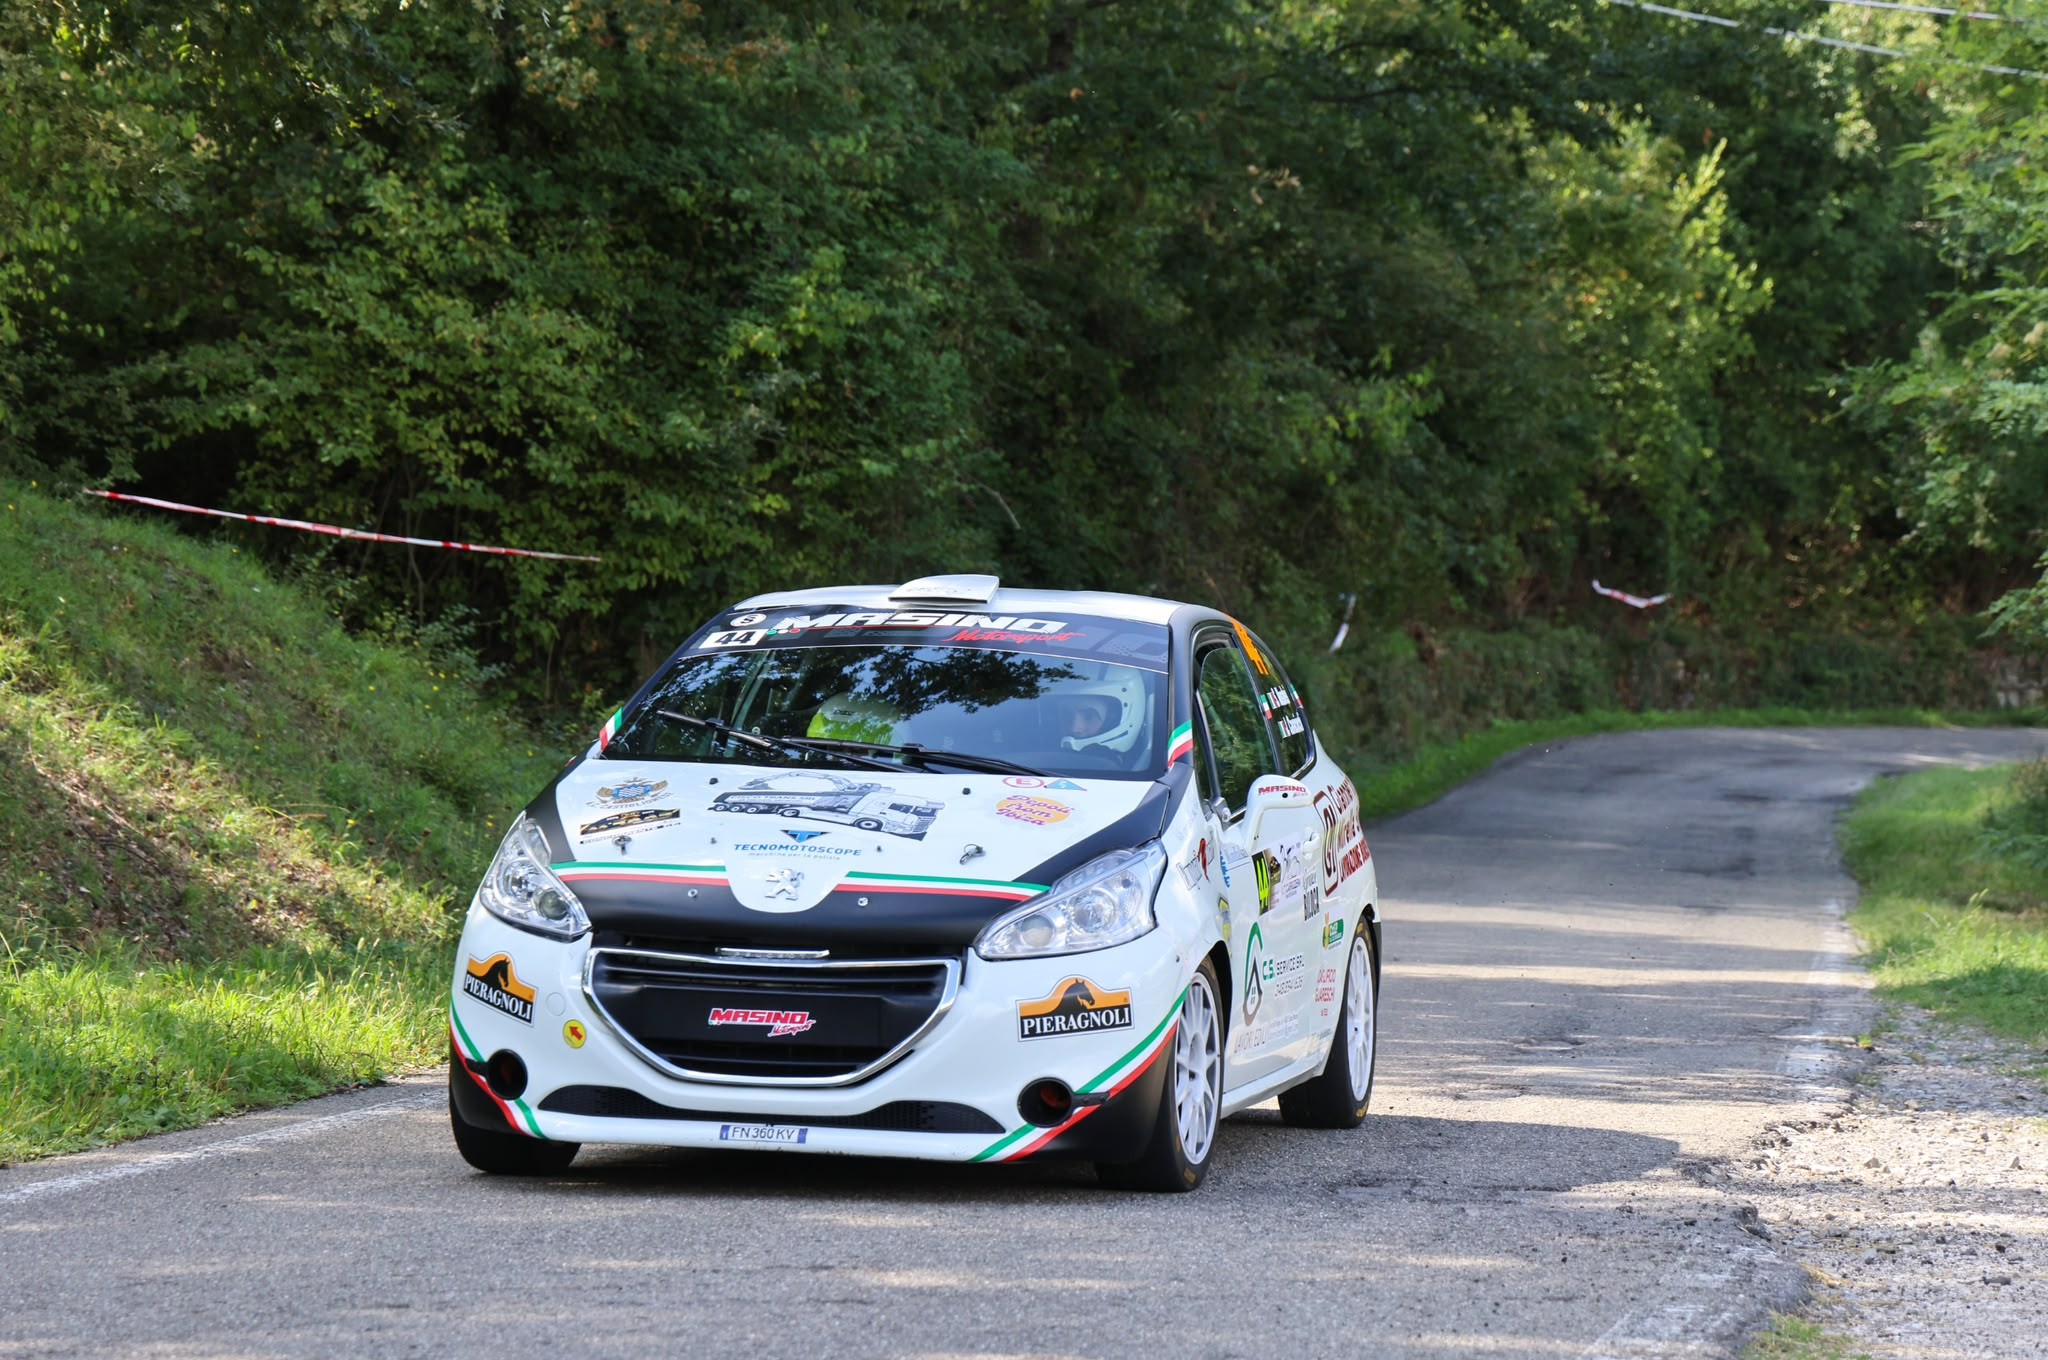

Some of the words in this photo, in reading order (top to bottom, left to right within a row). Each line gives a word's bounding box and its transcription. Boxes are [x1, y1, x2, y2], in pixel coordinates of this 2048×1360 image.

[772, 611, 1068, 634] MASINO
[715, 631, 752, 645] 44
[1258, 785, 1306, 795] MASINO
[734, 844, 862, 856] TECNOMOTOSCOPE
[1255, 857, 1270, 910] 44
[464, 974, 532, 1020] PIERAGNOLI
[710, 1008, 809, 1025] MASINO
[1022, 1006, 1131, 1036] PIERAGNOLI
